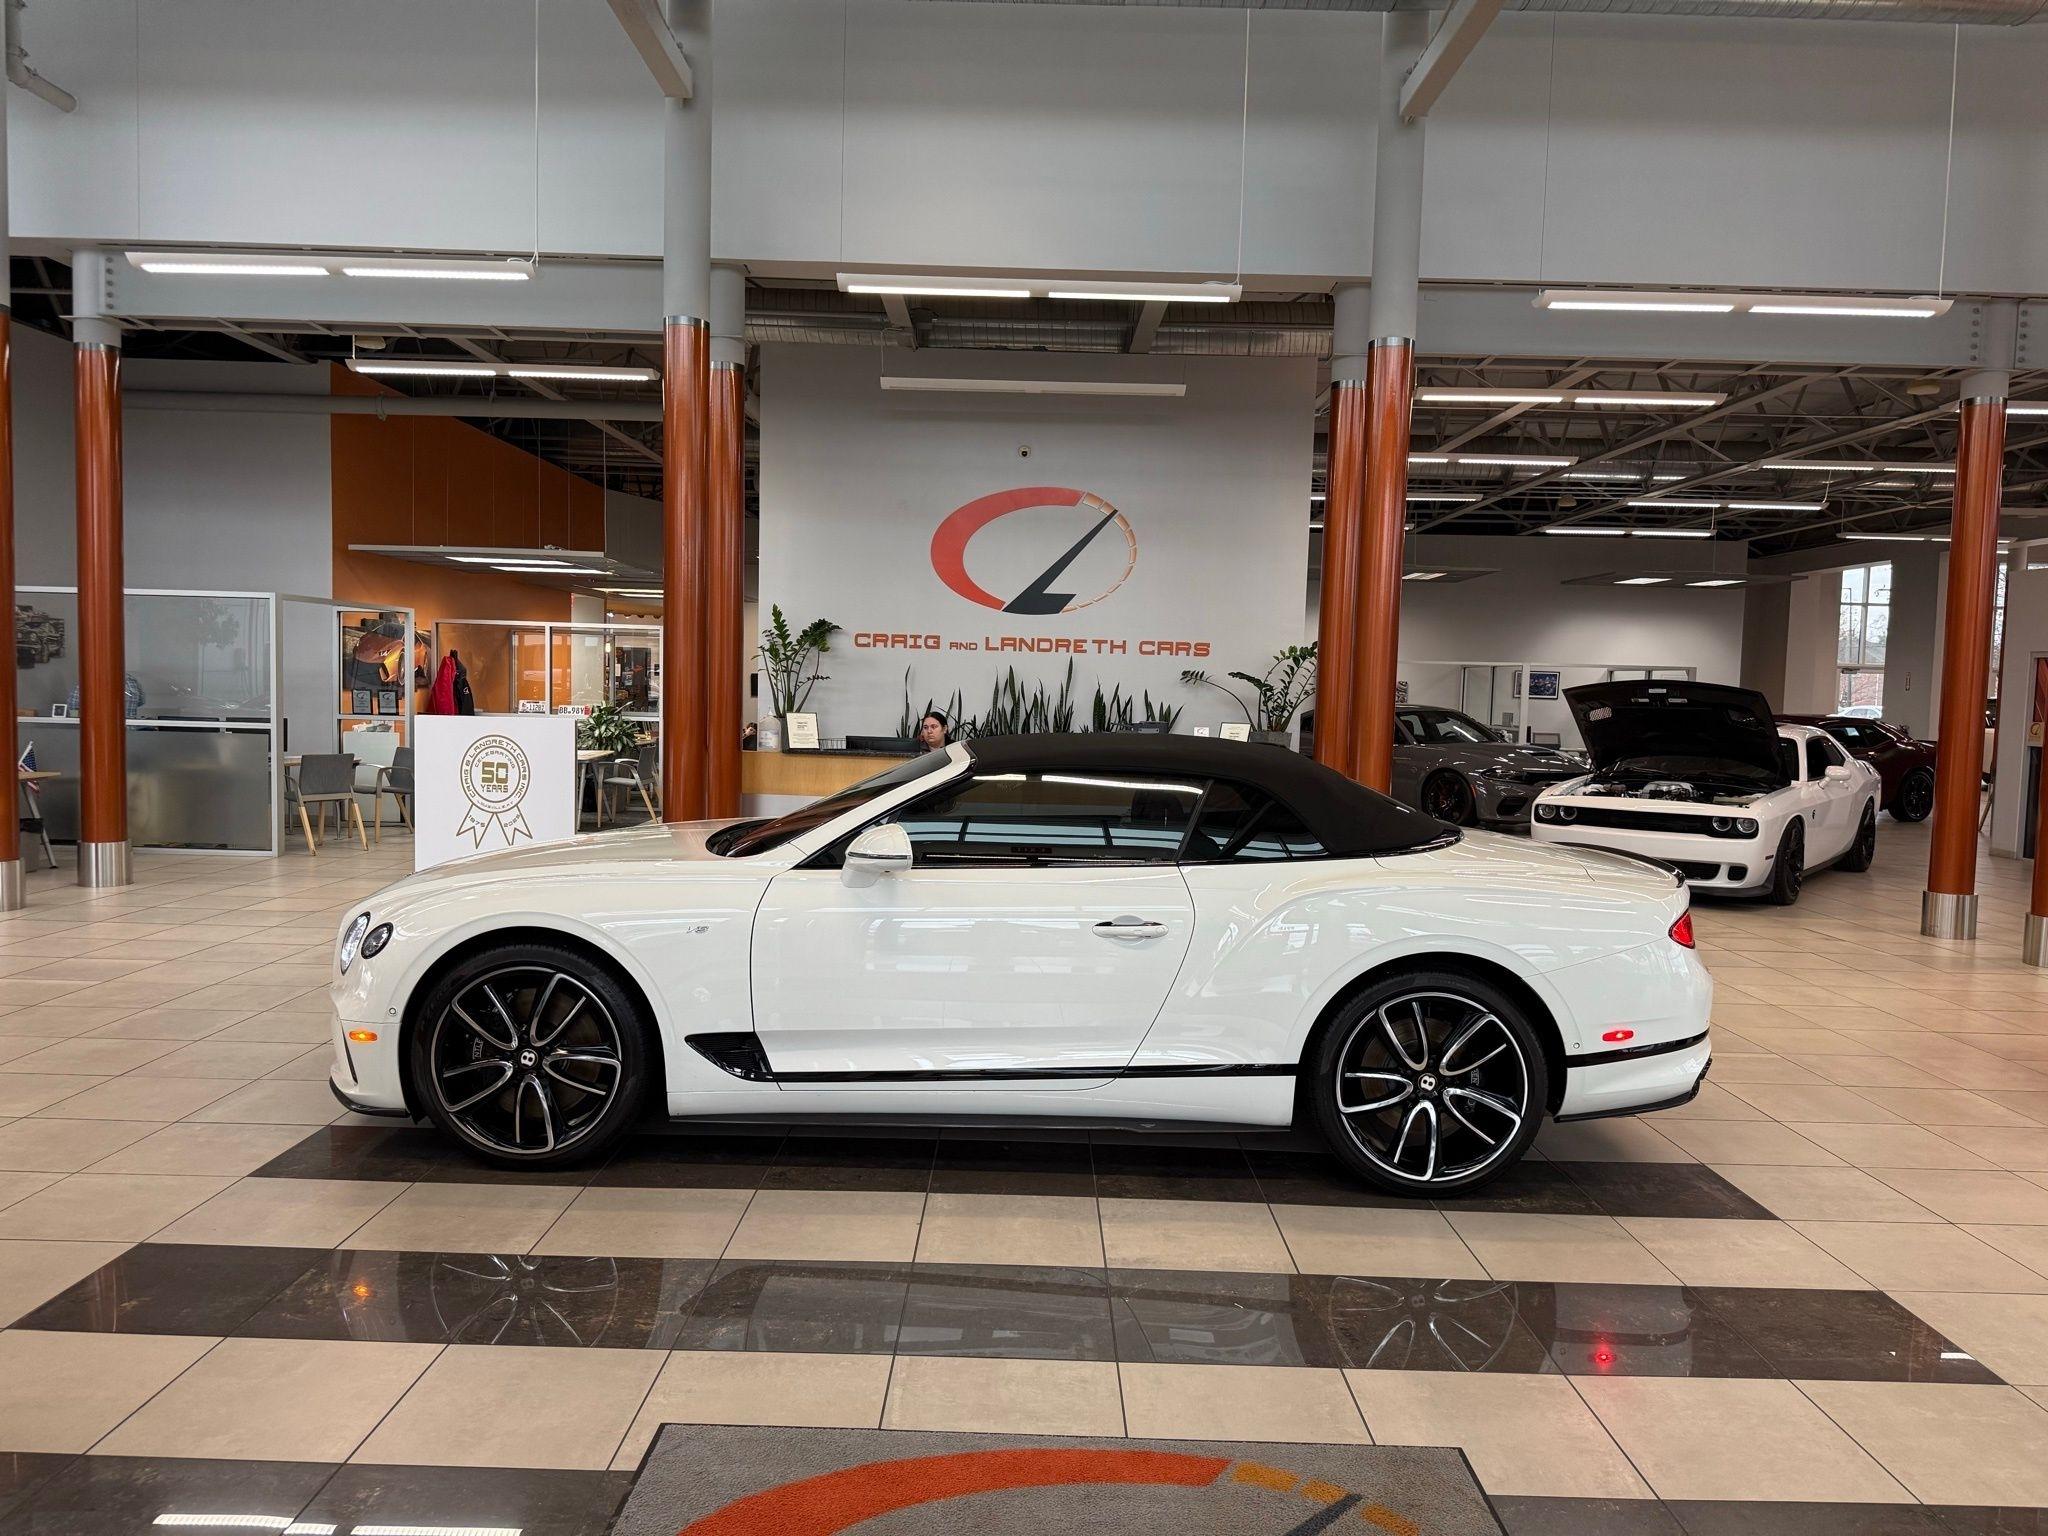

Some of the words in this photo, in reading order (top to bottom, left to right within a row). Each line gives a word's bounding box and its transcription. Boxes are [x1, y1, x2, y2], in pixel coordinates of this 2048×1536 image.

[854, 632, 941, 650] CRAIG
[949, 641, 978, 651] AND
[984, 636, 1127, 655] LANDRETH
[1138, 640, 1211, 657] CARS
[469, 739, 517, 758] LANDRETH
[516, 752, 527, 780] CARS
[481, 761, 509, 784] 50
[480, 784, 509, 793] YEARS
